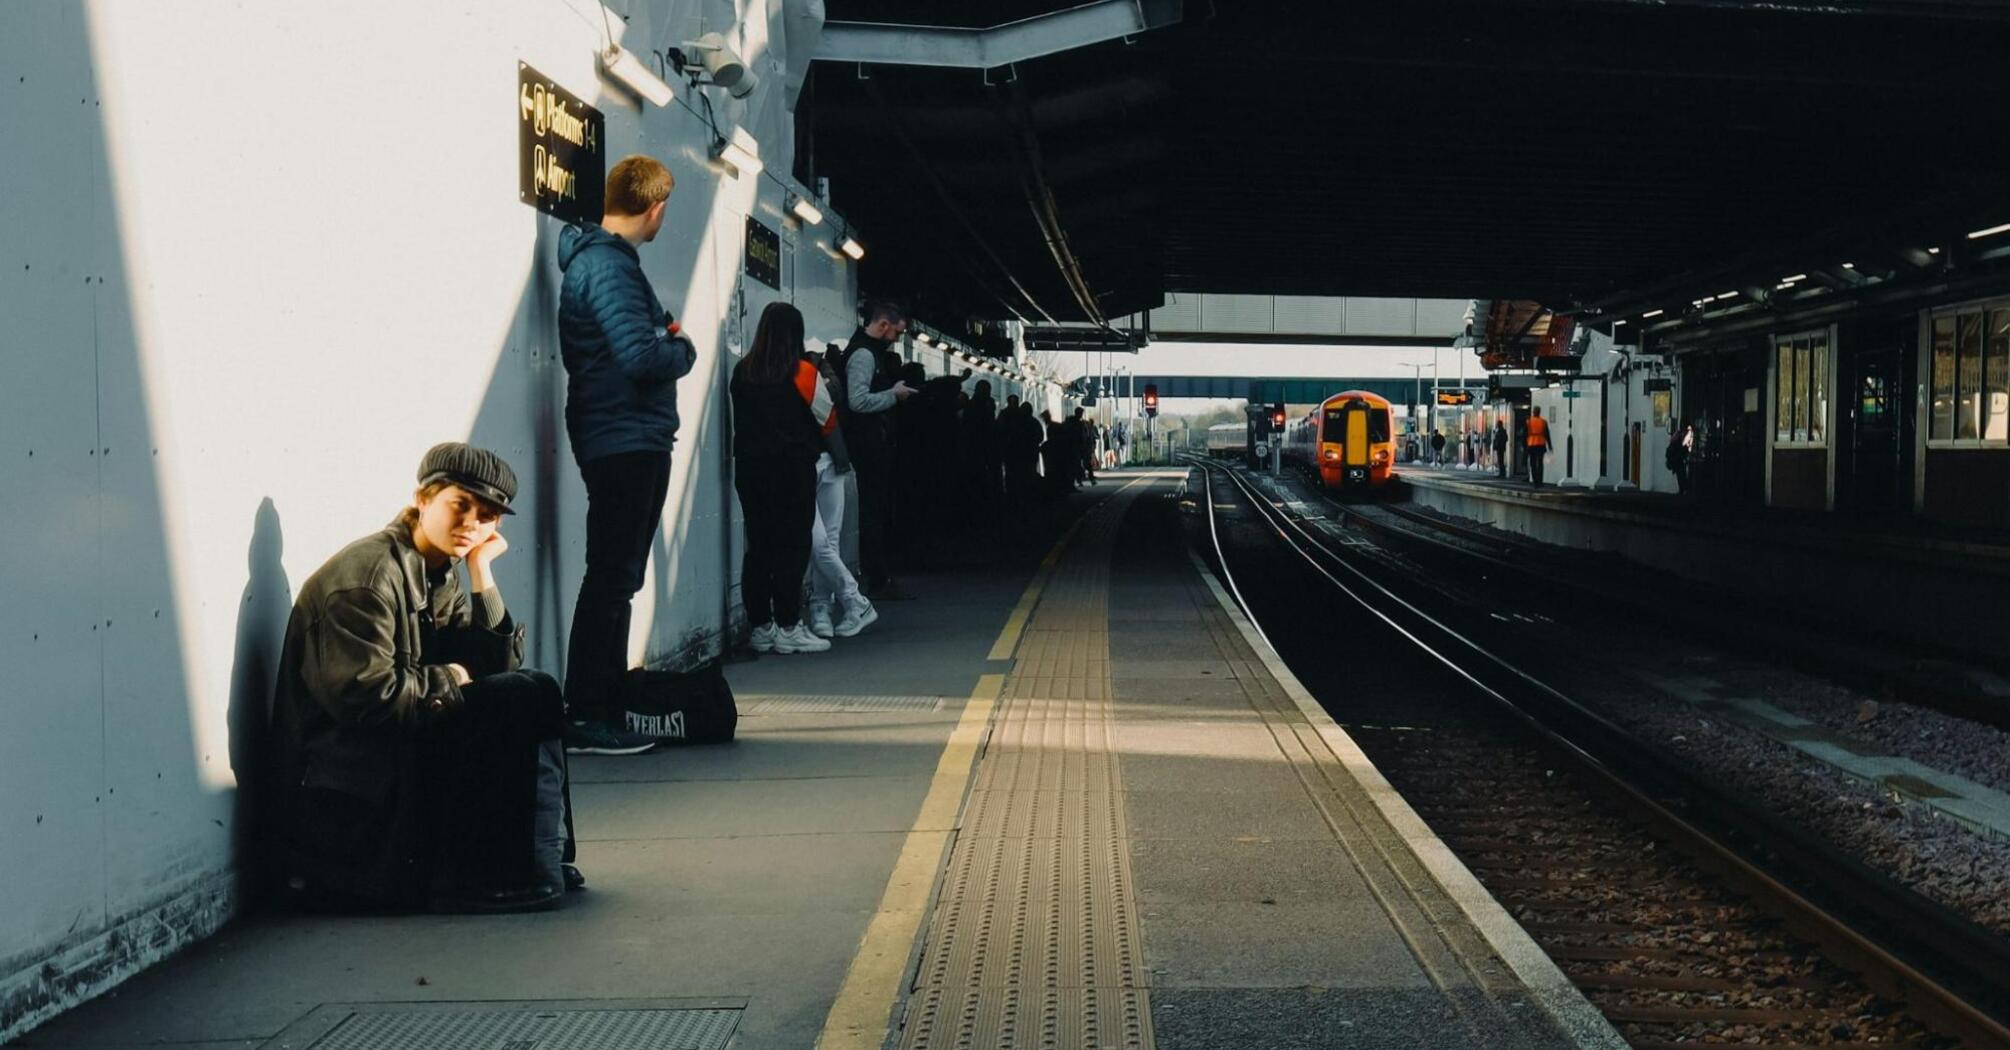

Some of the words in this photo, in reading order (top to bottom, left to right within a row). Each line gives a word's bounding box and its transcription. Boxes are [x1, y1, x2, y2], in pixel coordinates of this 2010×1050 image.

[547, 93, 583, 146] Platforms
[547, 154, 576, 203] Airport
[625, 710, 686, 738] EVERLAST
